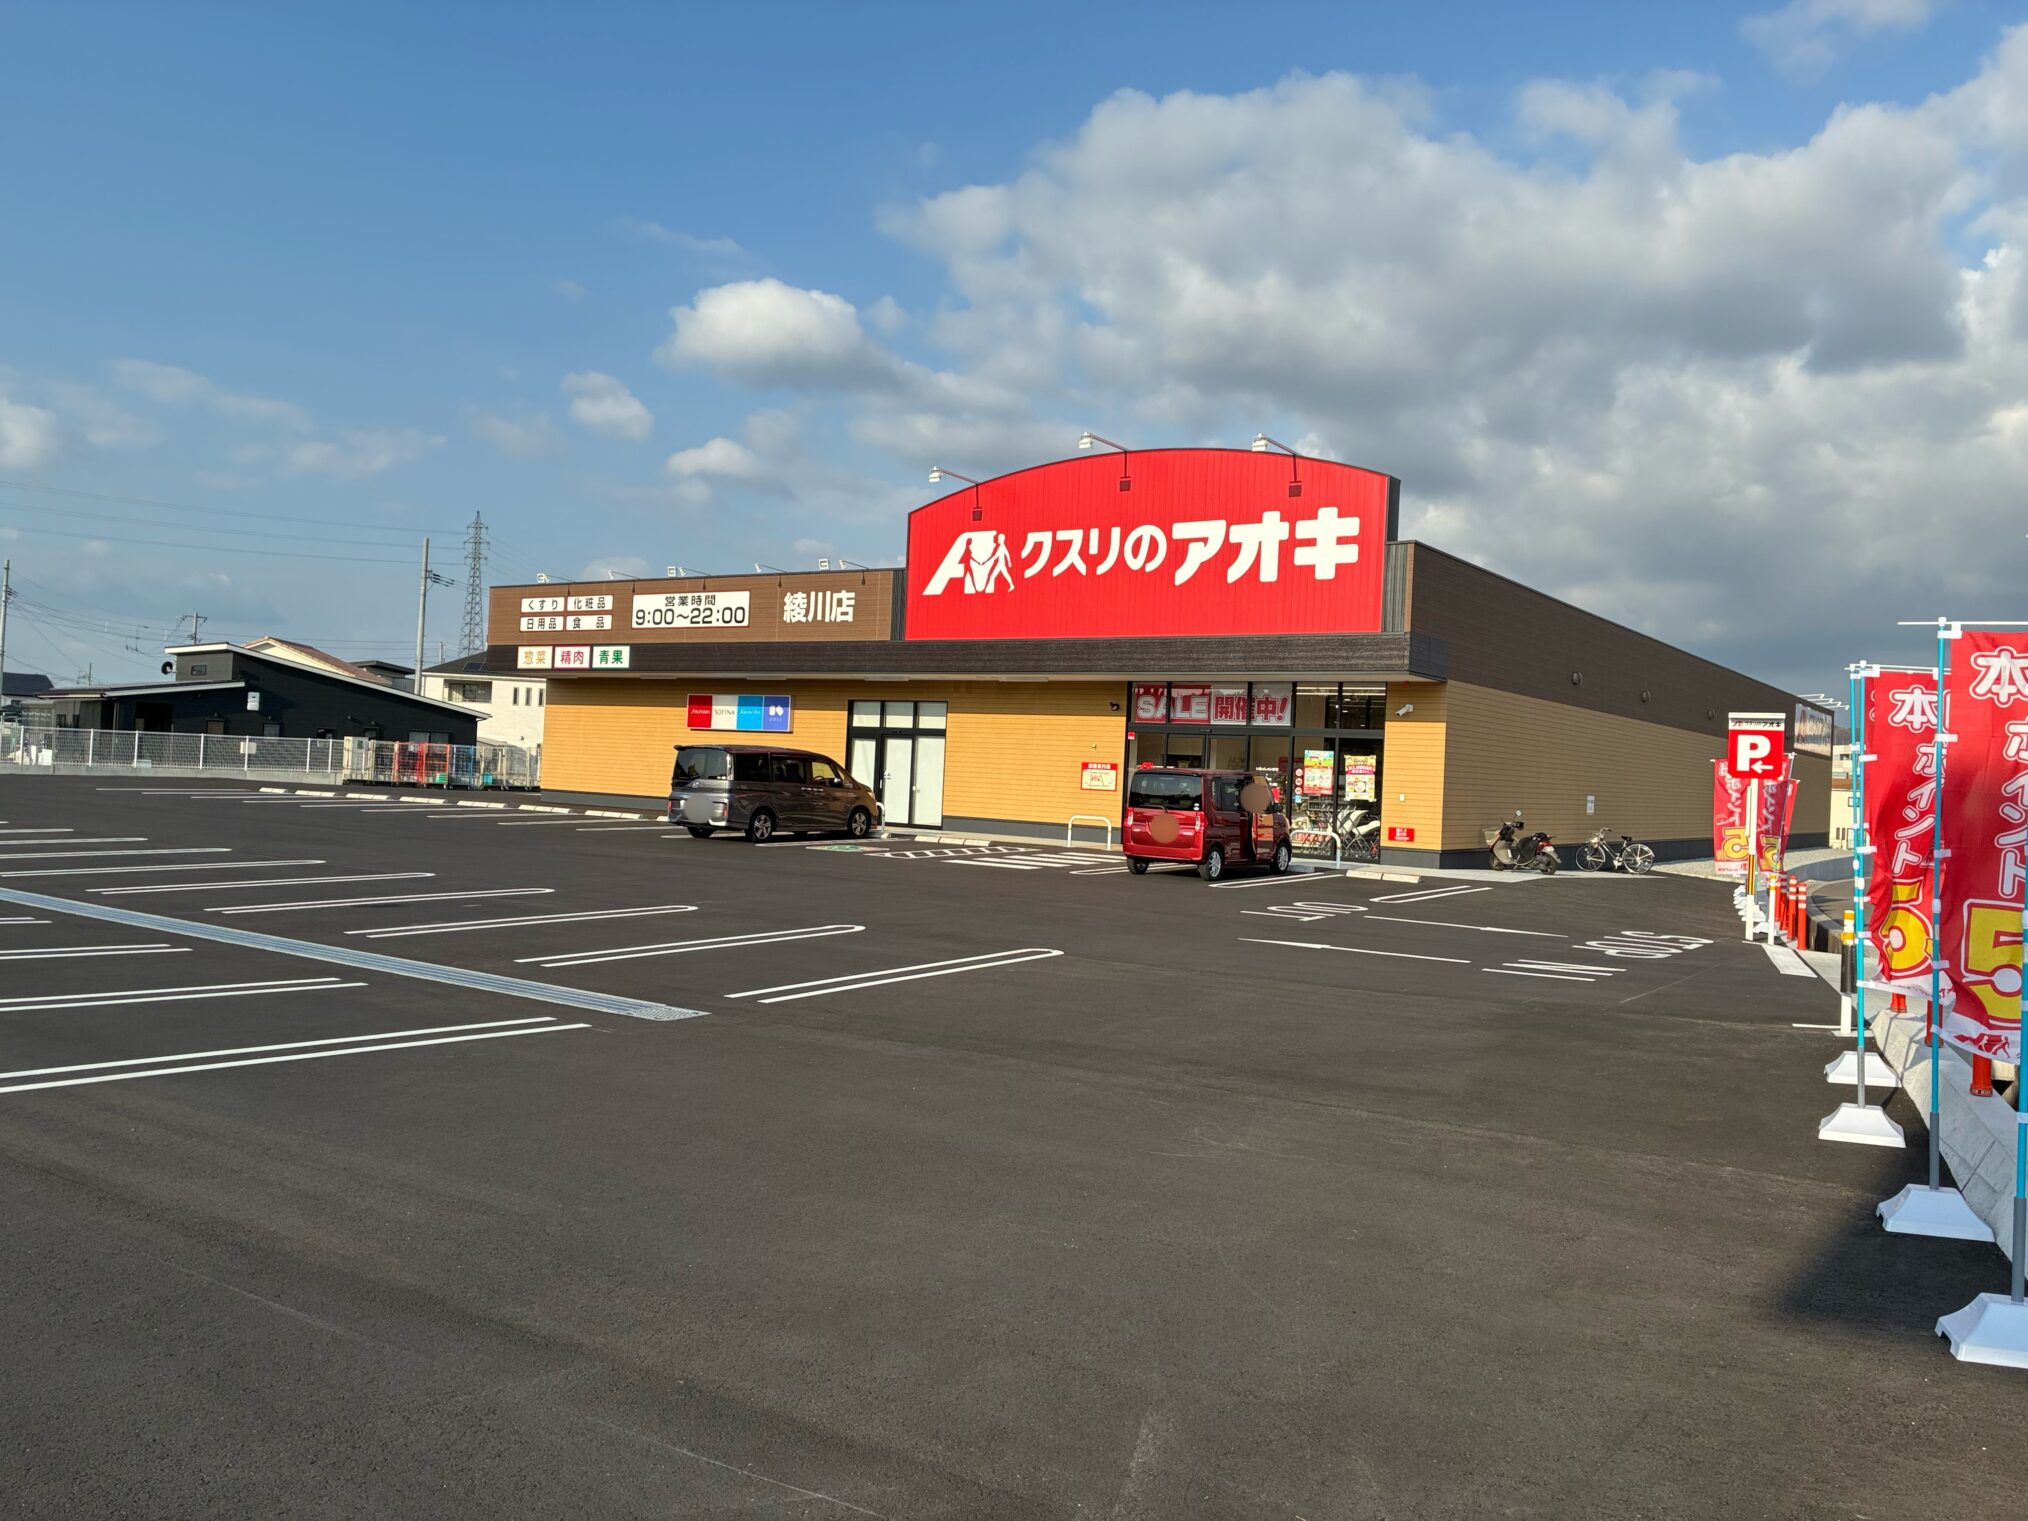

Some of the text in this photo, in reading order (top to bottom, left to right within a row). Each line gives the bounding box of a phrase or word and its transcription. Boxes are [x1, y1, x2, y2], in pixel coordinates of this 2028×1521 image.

[1021, 506, 1361, 587] クスリのアオキ
[528, 599, 558, 611] くすり
[573, 596, 606, 610] 化粧品
[664, 594, 716, 607] 営業時間
[783, 590, 856, 624] 綾川店
[526, 617, 557, 630] 日用品
[523, 650, 546, 665] 惣菜
[560, 650, 584, 665] 精肉
[598, 649, 623, 665] 青果
[1136, 694, 1209, 719] SALE
[1736, 734, 1771, 771] P
